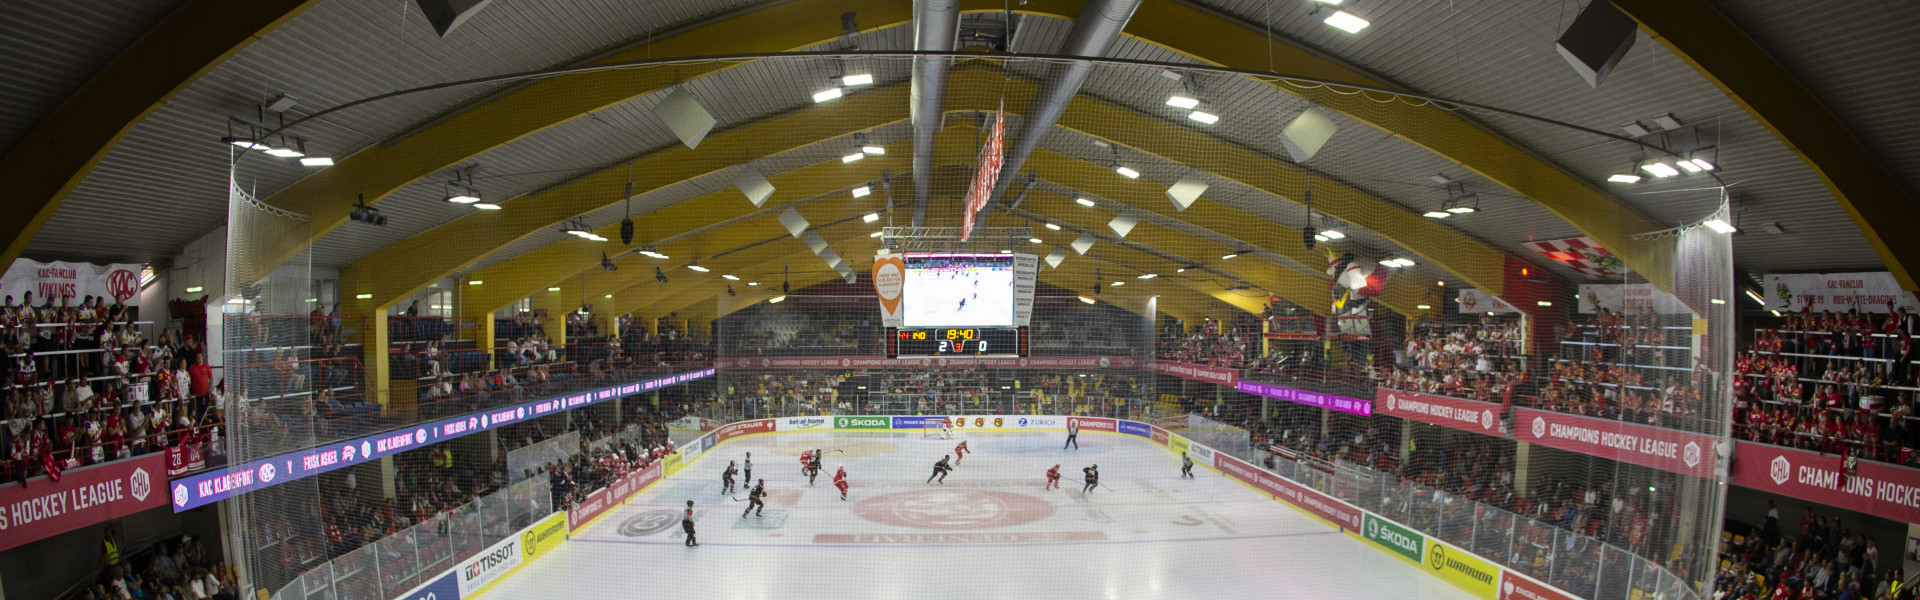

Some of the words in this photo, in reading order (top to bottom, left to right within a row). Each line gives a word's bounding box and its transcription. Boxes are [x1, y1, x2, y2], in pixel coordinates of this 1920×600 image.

[38, 268, 76, 279] KAC-FANCLUB
[39, 282, 76, 299] VIKINGS
[1827, 280, 1863, 289] KAC-FANCLUB
[1817, 294, 1825, 304] 19
[1833, 294, 1897, 305] RED-WTE-DRAGONS
[946, 329, 974, 340] 19:40
[939, 341, 948, 352] 2
[955, 343, 961, 351] 3
[978, 341, 987, 351] 0
[1398, 399, 1430, 415] CHAMPIONS
[1430, 405, 1453, 418] HOCKEY
[1454, 408, 1479, 424] LEAGUE
[851, 418, 886, 426] ŠKODA
[1550, 423, 1600, 444] CHAMPIONS
[1601, 431, 1638, 451] HOCKEY
[1640, 438, 1678, 459] LEAGUE
[171, 453, 181, 466] 28
[303, 454, 320, 470] FRISK
[320, 451, 338, 467] ASKER
[1773, 458, 1788, 481] CHL
[131, 471, 149, 498] CHL
[198, 480, 213, 498] KAC
[1798, 465, 1874, 498] CHAMPONS
[11, 491, 67, 527] HOCKEY
[72, 479, 124, 511] LEAGUE
[1380, 525, 1418, 554] ŠKODA
[480, 541, 514, 573] TISSOT
[1446, 557, 1493, 585] WARRIOR
